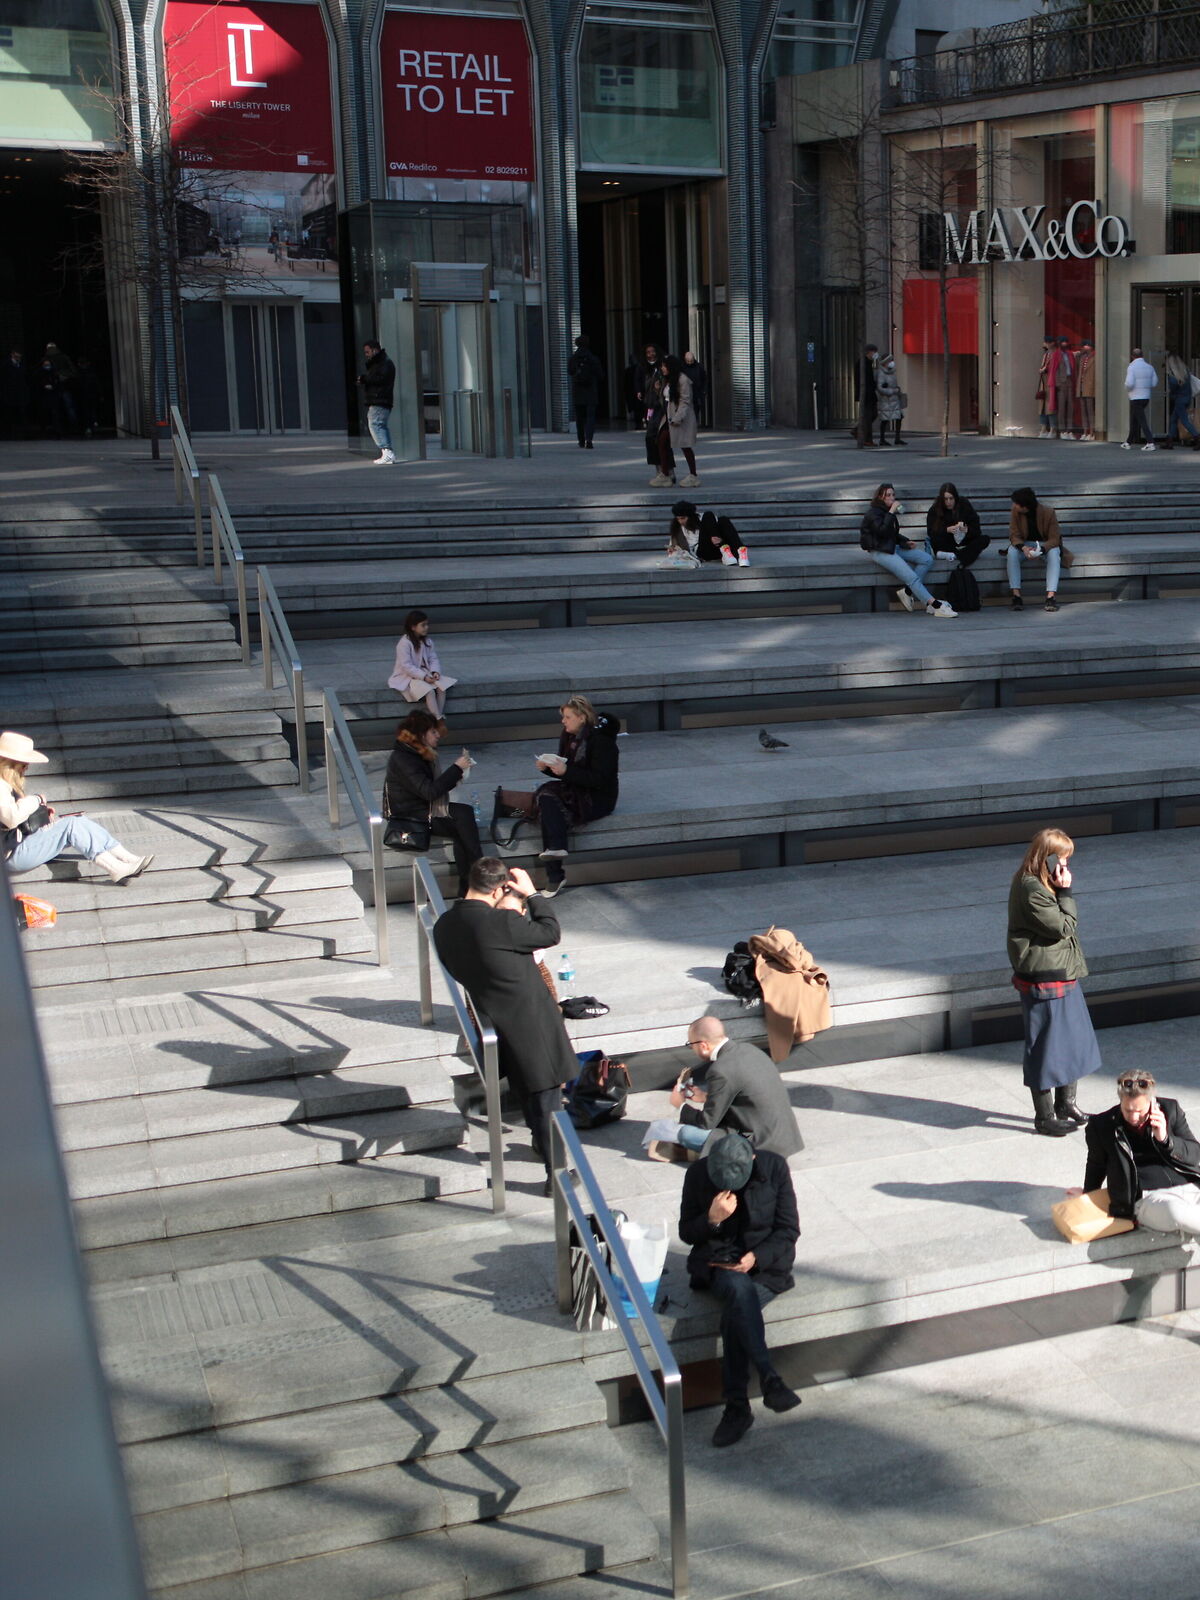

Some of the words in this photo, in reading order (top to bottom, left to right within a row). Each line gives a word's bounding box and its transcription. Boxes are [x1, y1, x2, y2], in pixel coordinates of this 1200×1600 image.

[399, 49, 512, 82] RETAIL
[210, 100, 227, 109] THE
[228, 101, 261, 111] LIBERTY
[262, 103, 291, 112] TOWER
[396, 83, 445, 113] TO
[455, 87, 515, 116] LET
[389, 162, 408, 171] GVA
[485, 166, 495, 175] 02
[496, 167, 528, 175] 8029211
[943, 200, 1128, 265] MAX&Co.
